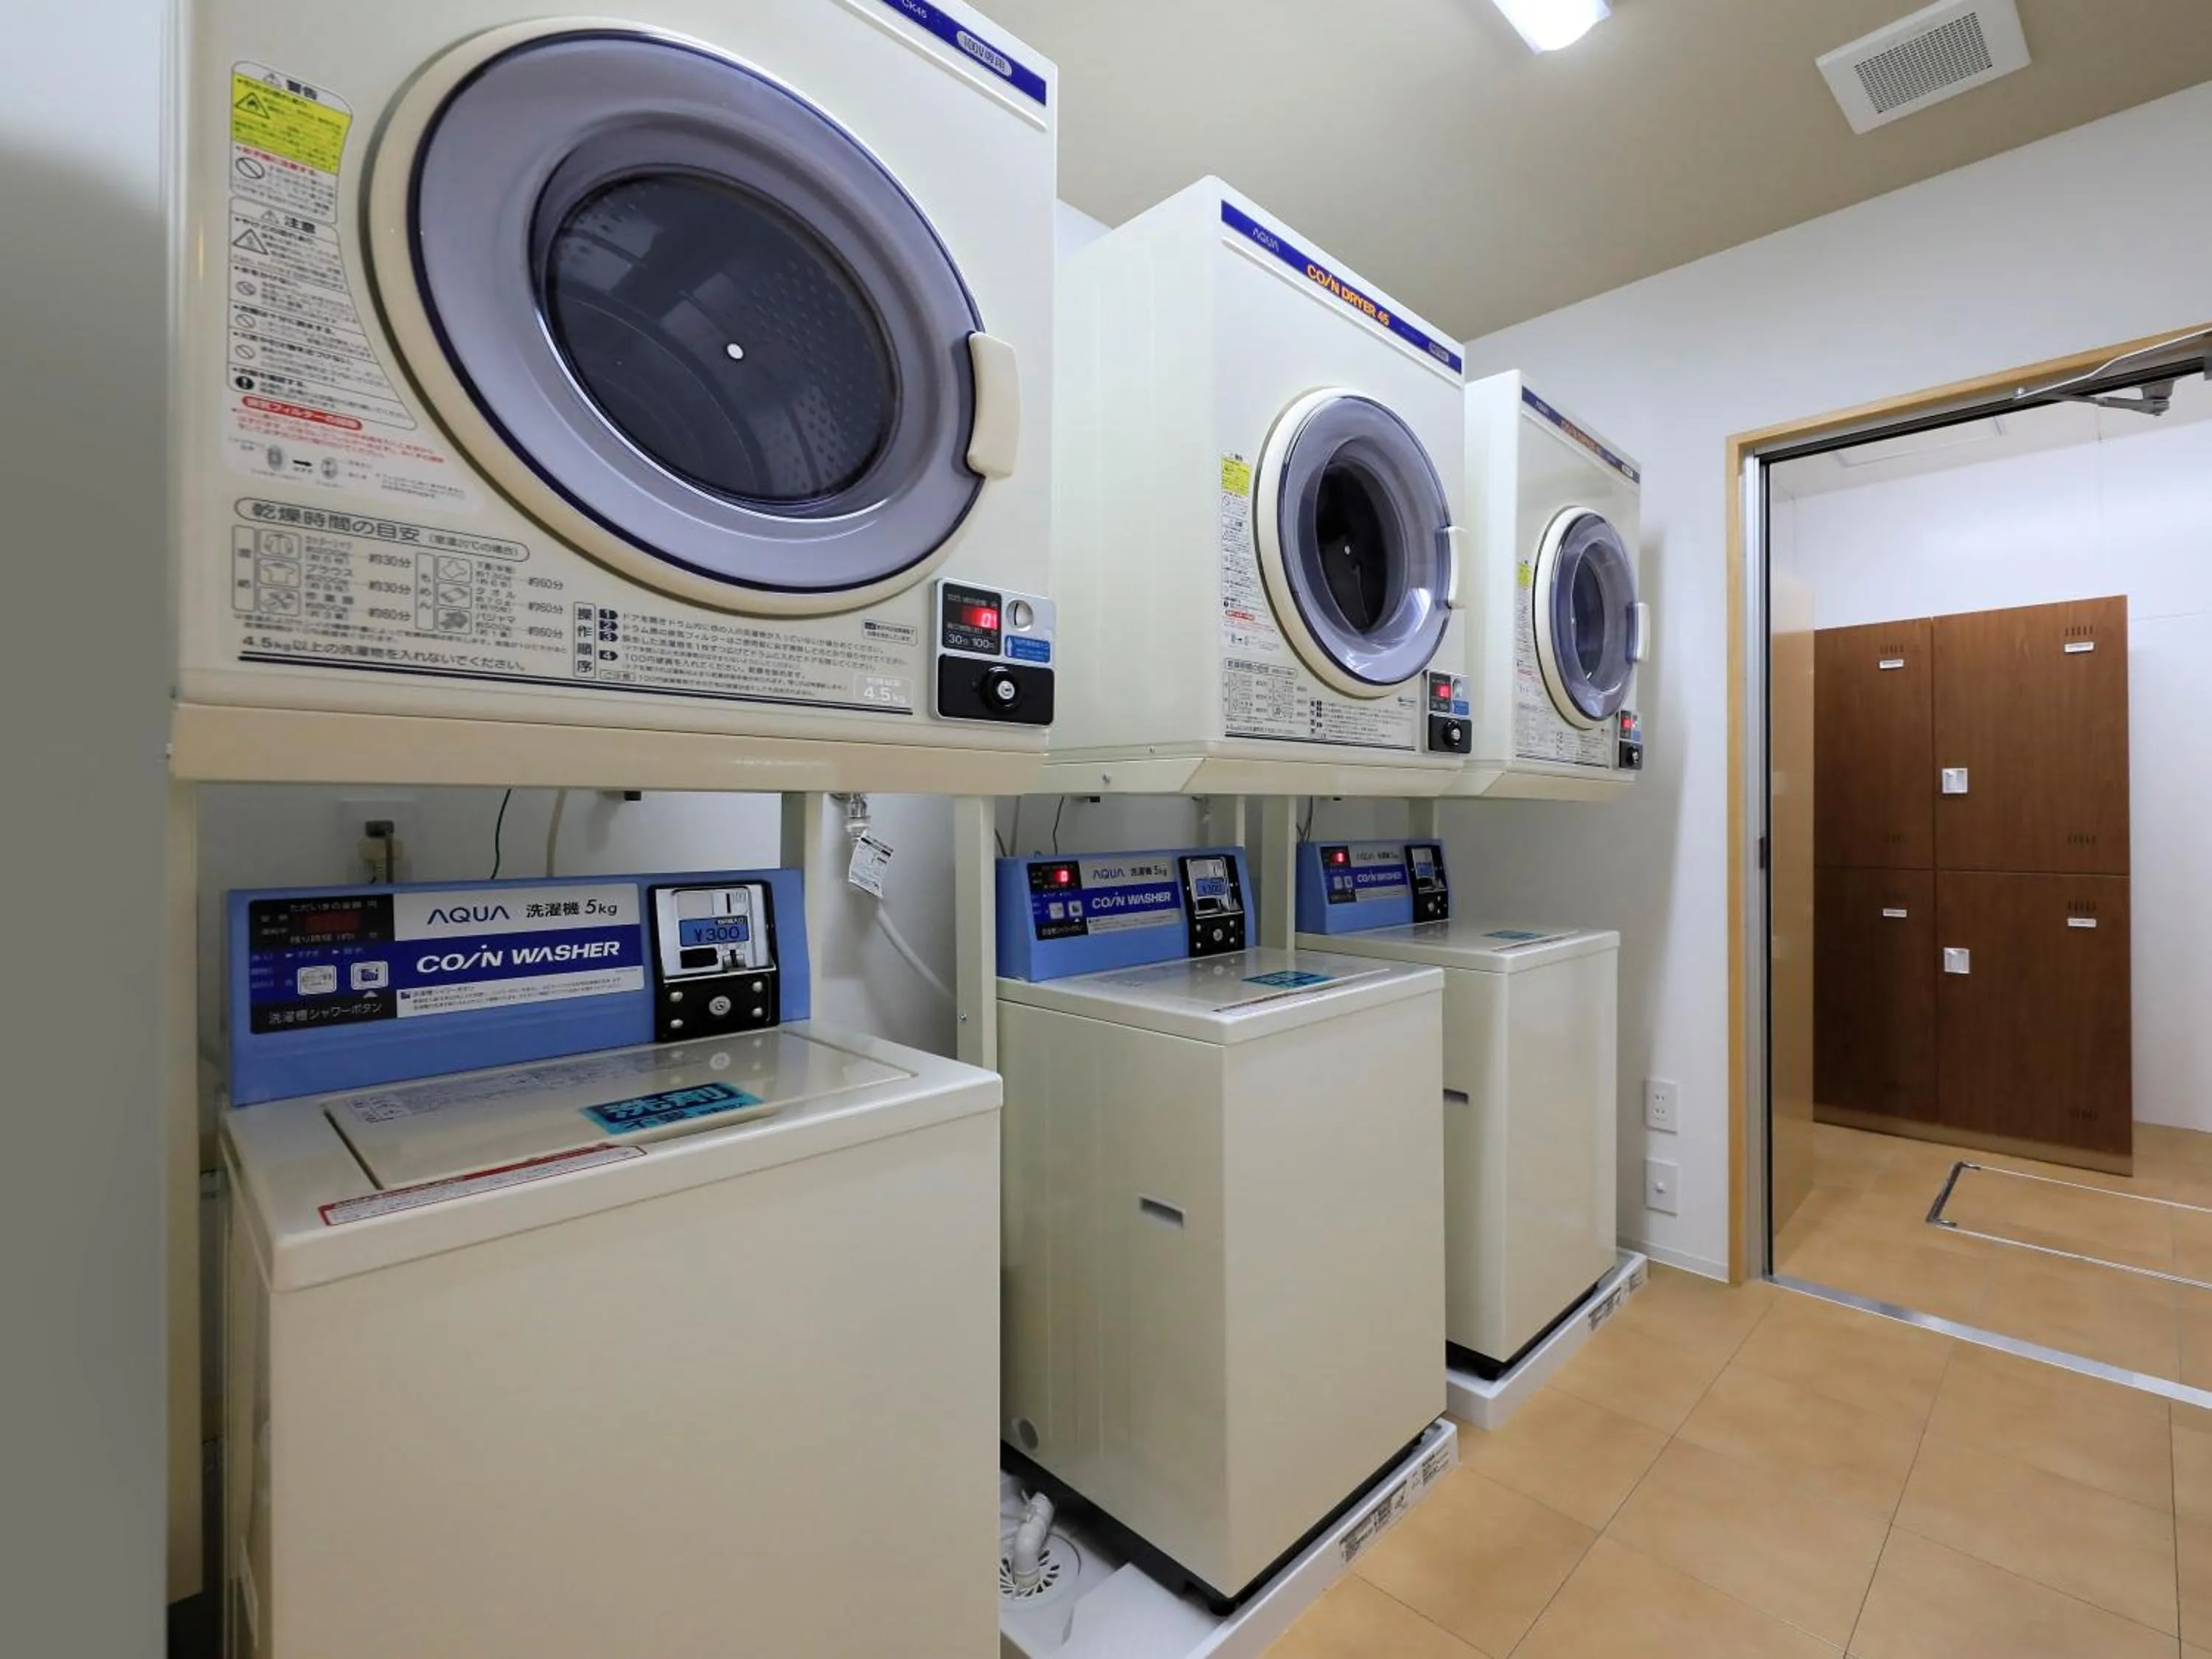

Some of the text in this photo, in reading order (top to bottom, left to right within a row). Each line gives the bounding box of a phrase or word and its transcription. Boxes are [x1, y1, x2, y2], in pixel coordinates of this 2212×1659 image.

[1341, 285, 1377, 319] DRYER
[251, 502, 421, 544] 乾燥時間の目安
[1092, 867, 1125, 880] AQUA
[1127, 891, 1172, 905] WASHER
[426, 898, 619, 926] AQUA 洗濯機 5kg
[511, 940, 622, 965] WASHER
